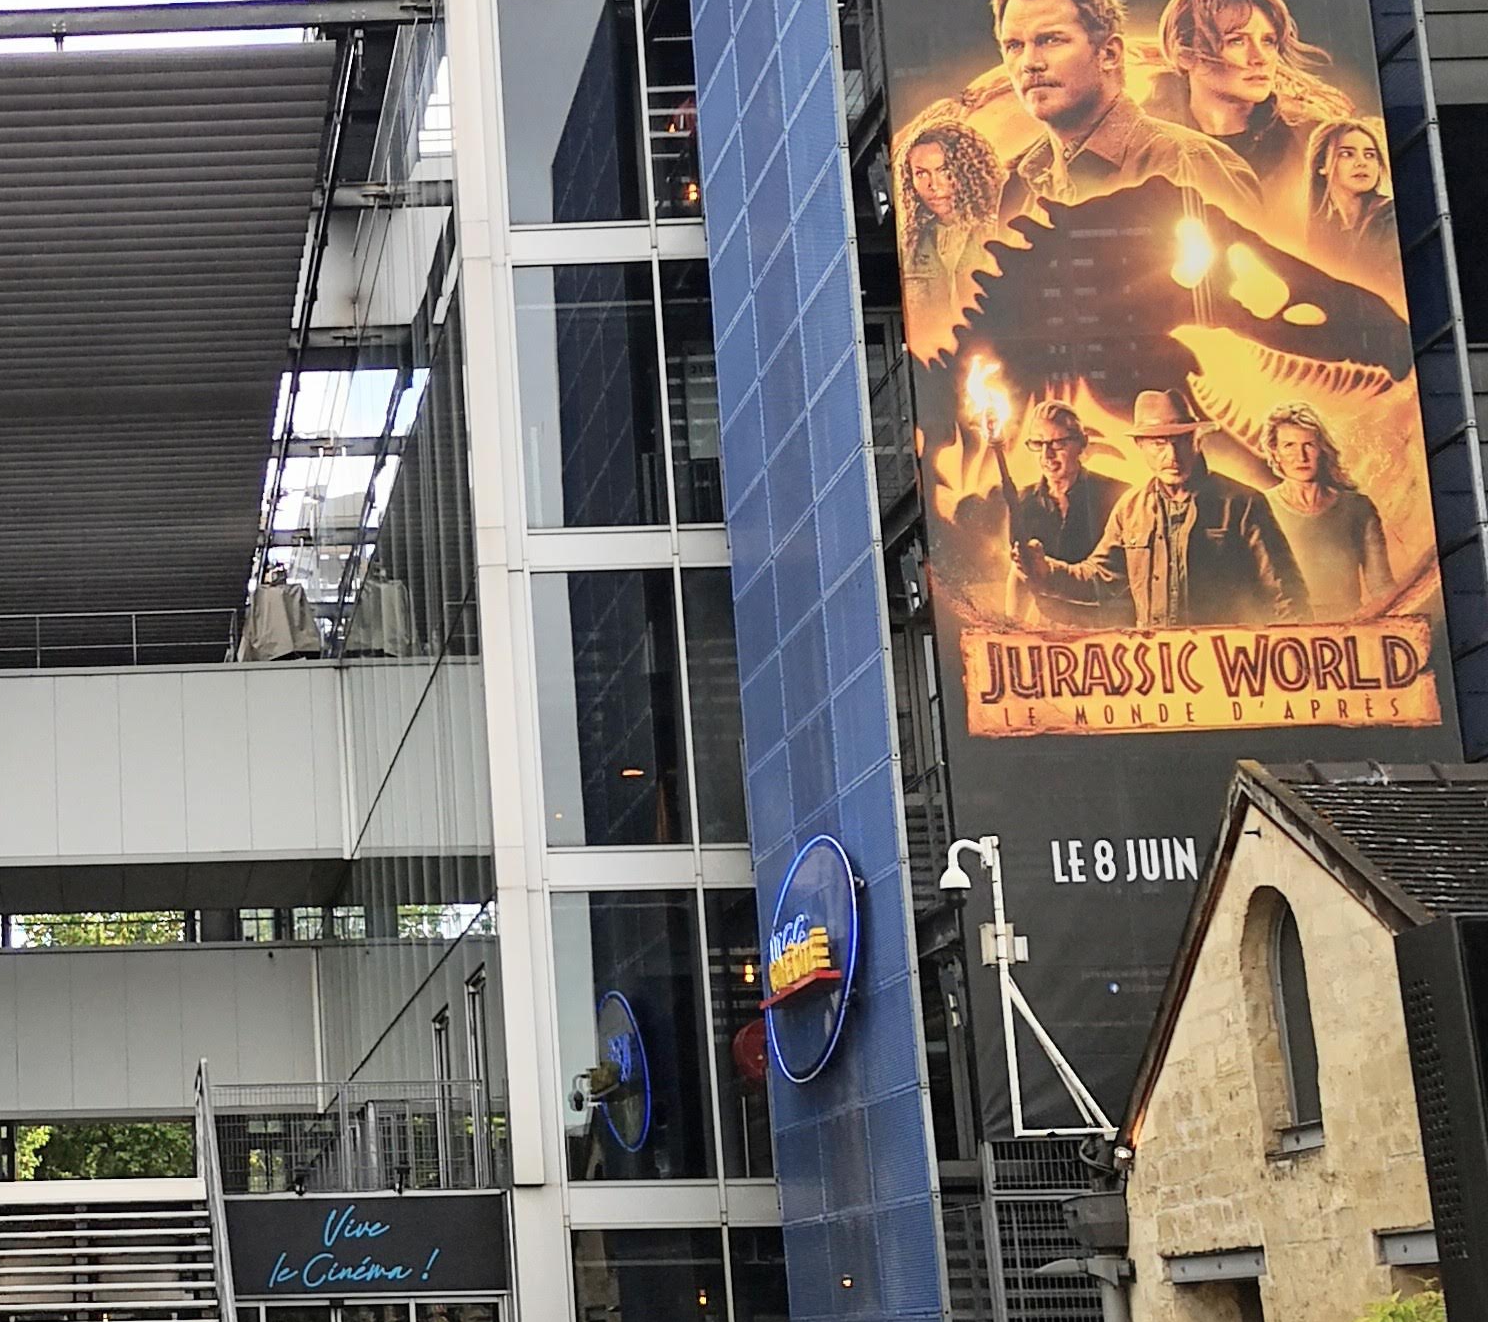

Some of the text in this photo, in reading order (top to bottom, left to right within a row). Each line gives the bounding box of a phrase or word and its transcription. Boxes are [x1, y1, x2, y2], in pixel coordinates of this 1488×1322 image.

[980, 634, 1420, 705] JURASSIC WORLD
[1003, 693, 1400, 728] LE MONDE D'APRÈS
[1050, 836, 1200, 885] LE 8 JUIN
[324, 1204, 391, 1247] Vive
[268, 1247, 441, 1288] le Cinéma !
